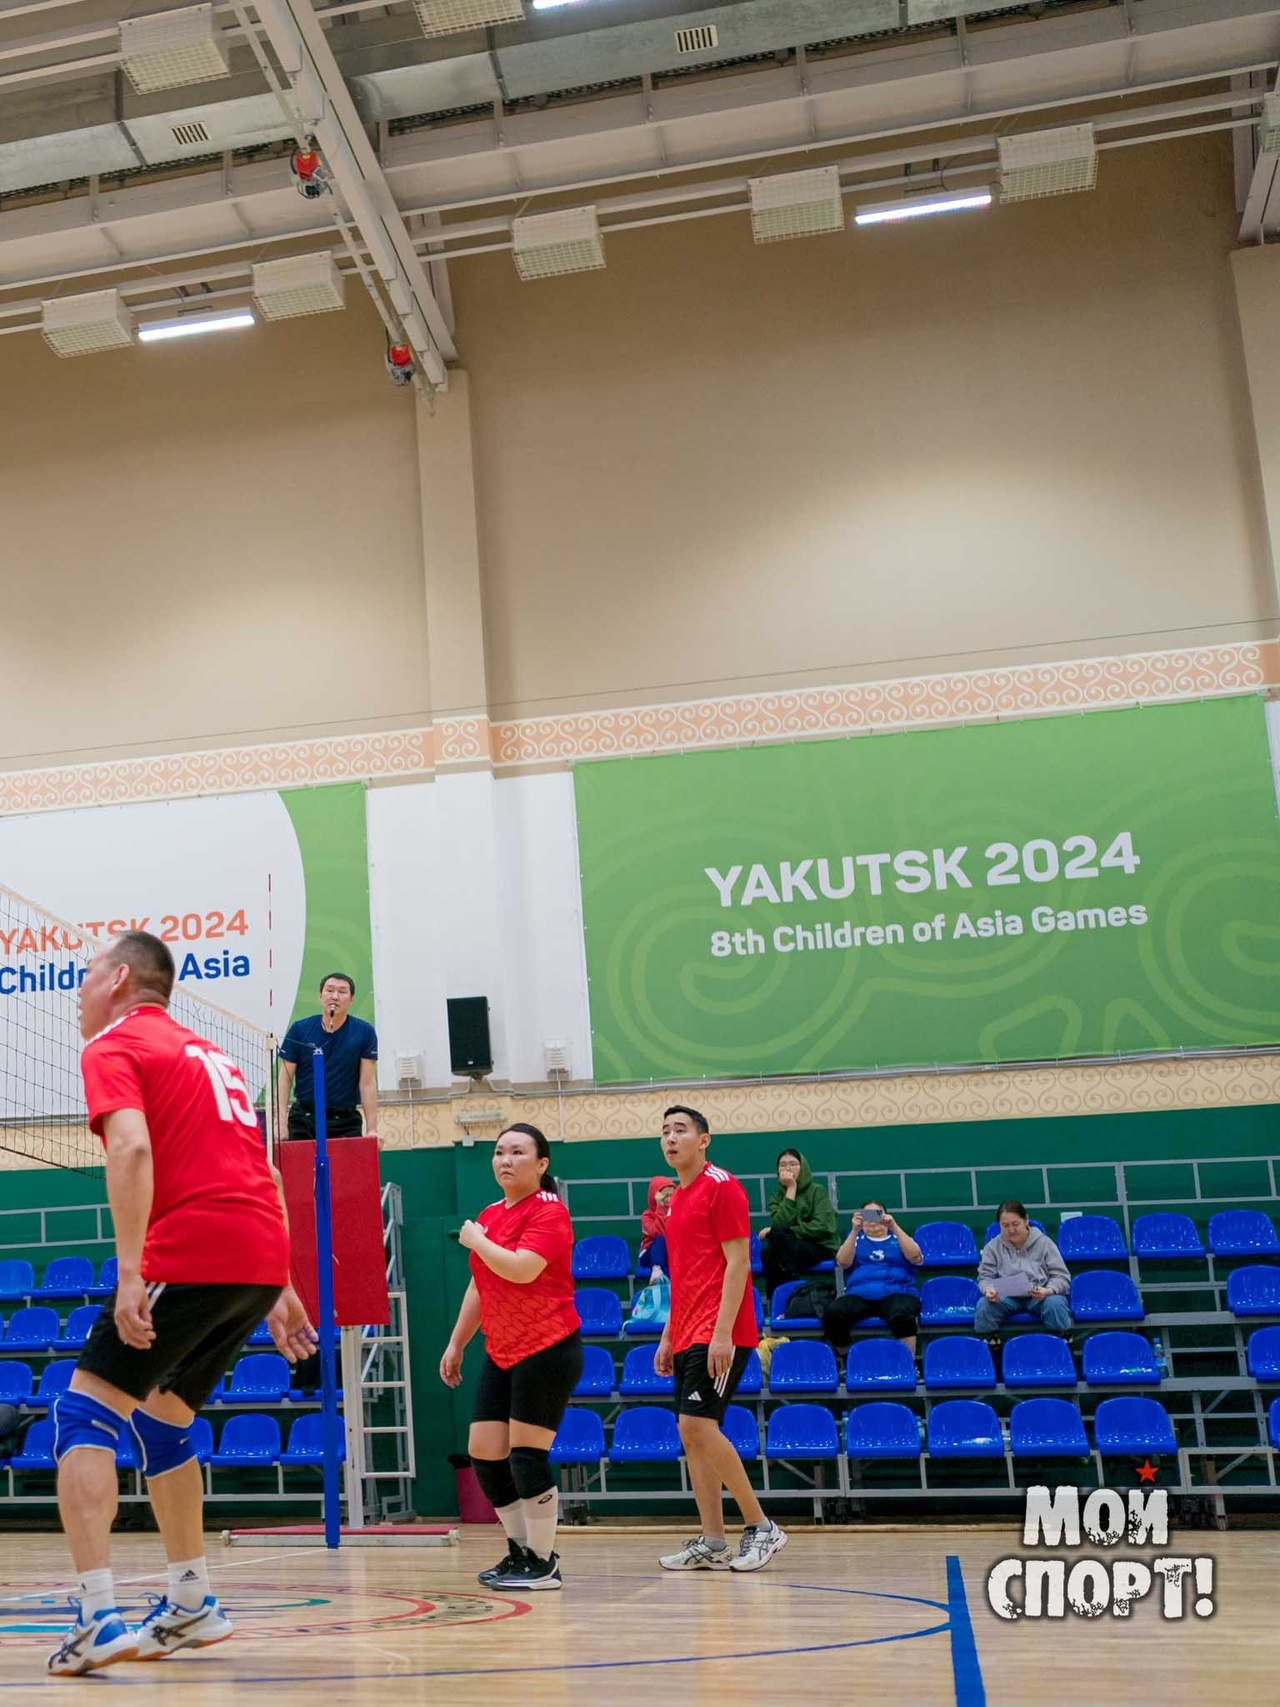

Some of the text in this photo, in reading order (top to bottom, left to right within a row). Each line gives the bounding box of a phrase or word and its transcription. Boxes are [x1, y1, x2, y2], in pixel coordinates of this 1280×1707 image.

[704, 831, 1140, 907] YAKUTSK 2024
[160, 909, 249, 943] 2024
[710, 904, 1148, 957] 8th Children of Asia Games
[178, 949, 250, 981] Asia
[185, 1044, 257, 1128] 15
